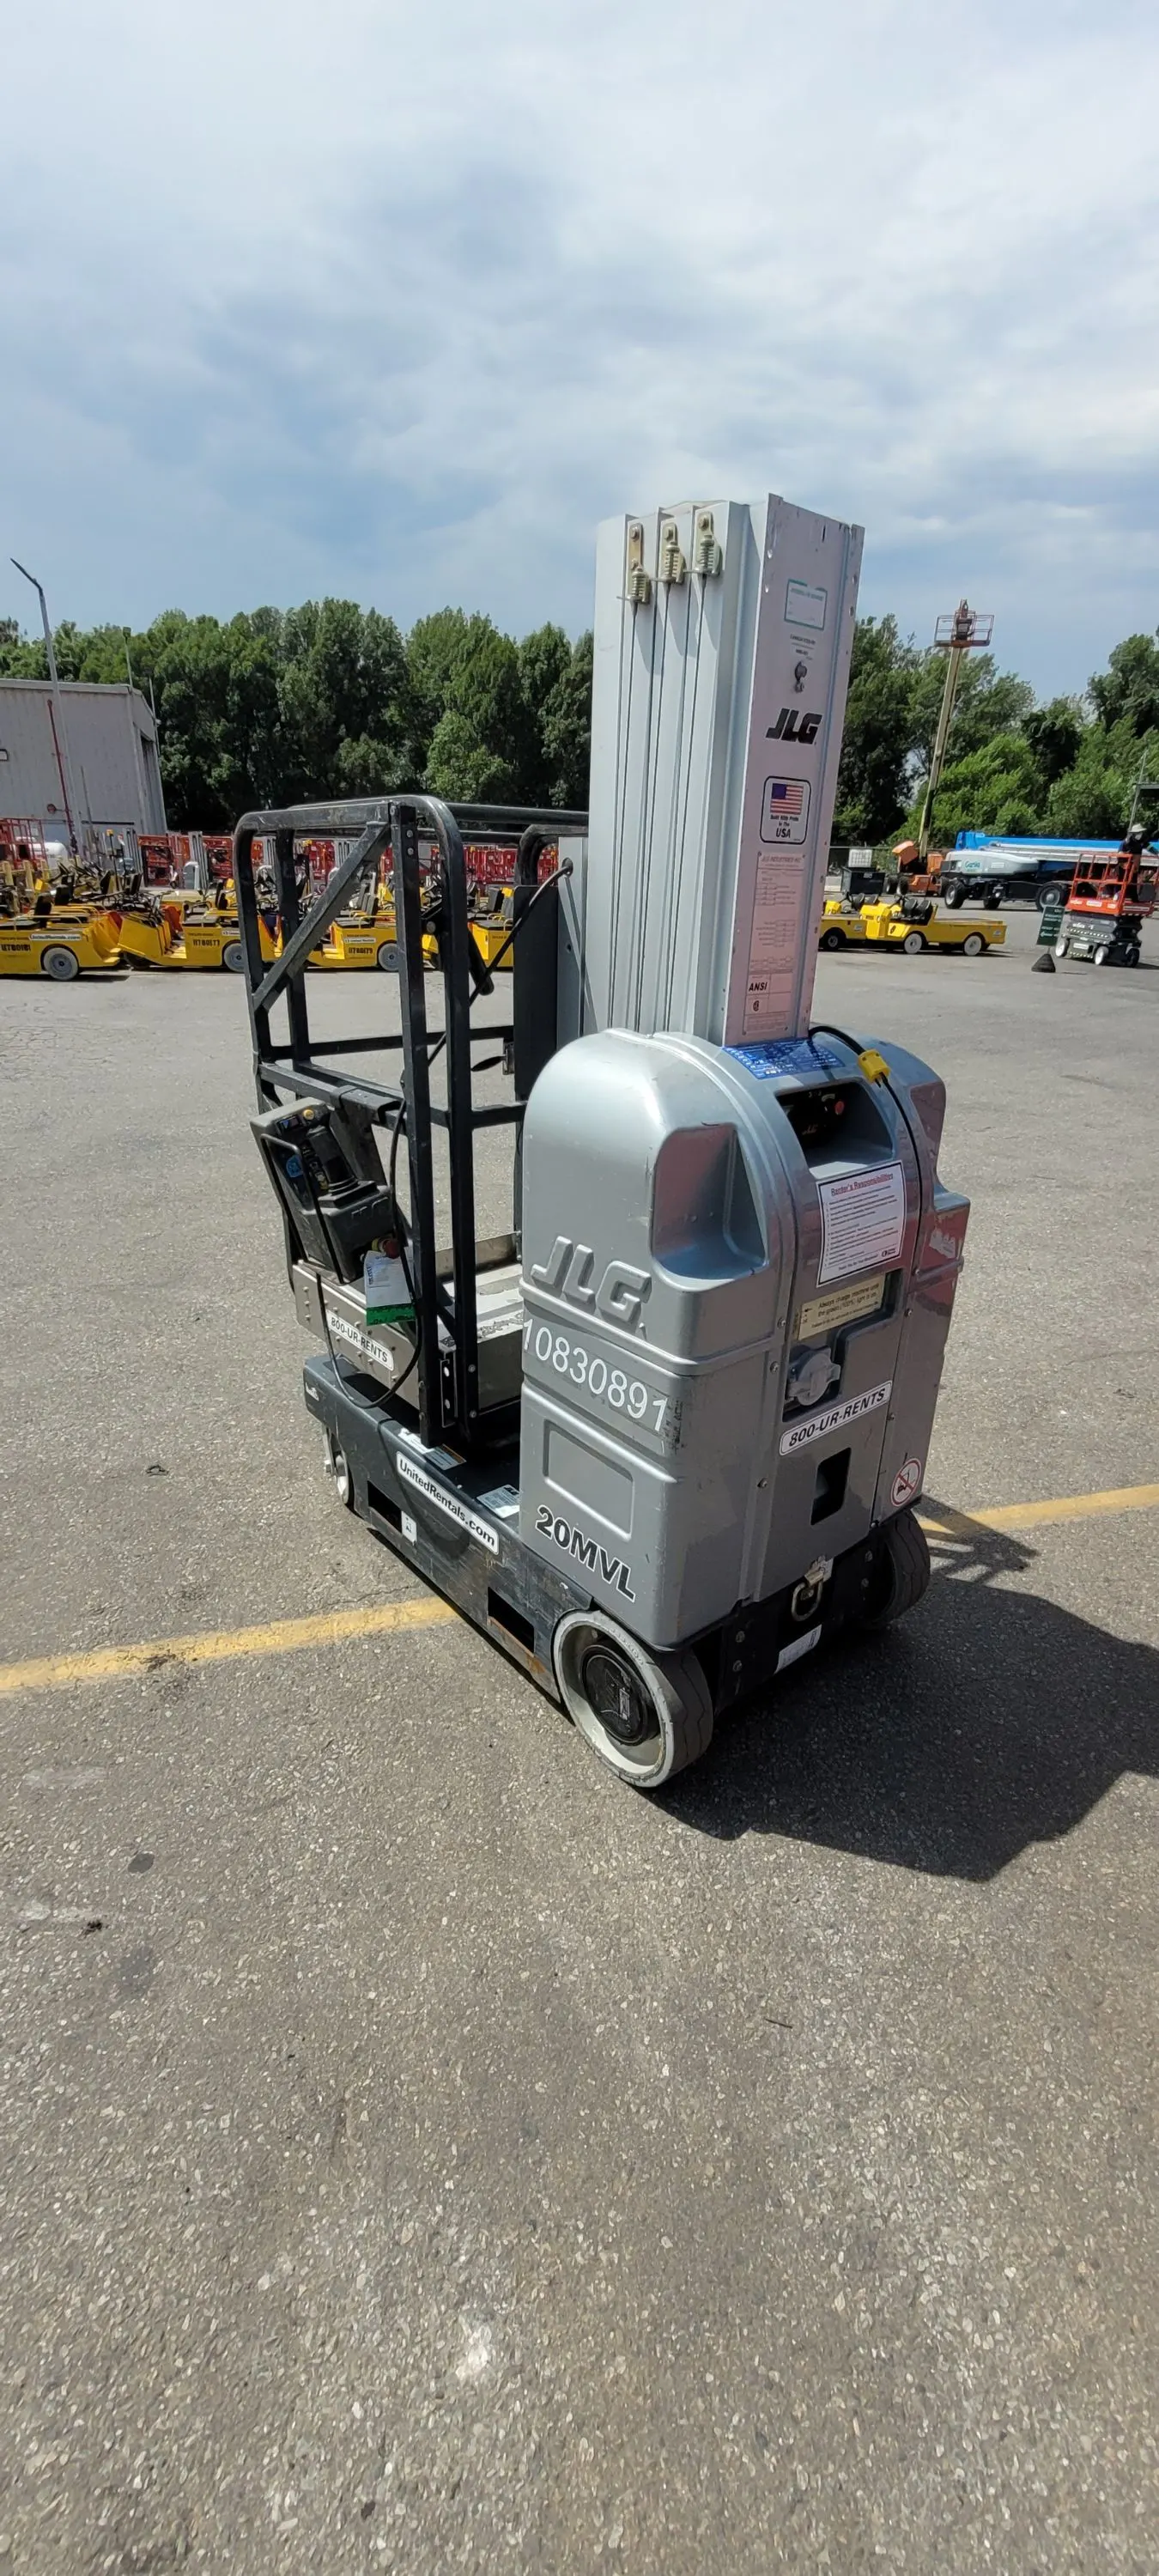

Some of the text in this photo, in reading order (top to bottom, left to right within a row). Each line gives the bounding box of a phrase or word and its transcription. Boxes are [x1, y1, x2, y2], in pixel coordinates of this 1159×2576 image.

[766, 708, 822, 745] JLG
[775, 827, 791, 838] USA
[748, 981, 768, 992] ANSI
[831, 1184, 854, 1197] Renter's
[531, 1236, 652, 1329] JLG
[331, 1316, 388, 1363] 800-UR-RENTS
[523, 1318, 669, 1432] 10830891
[788, 1388, 886, 1447] 800-UR-RENTS
[399, 1458, 495, 1546] UnitedRentals.com
[535, 1504, 636, 1603] 20MVL
